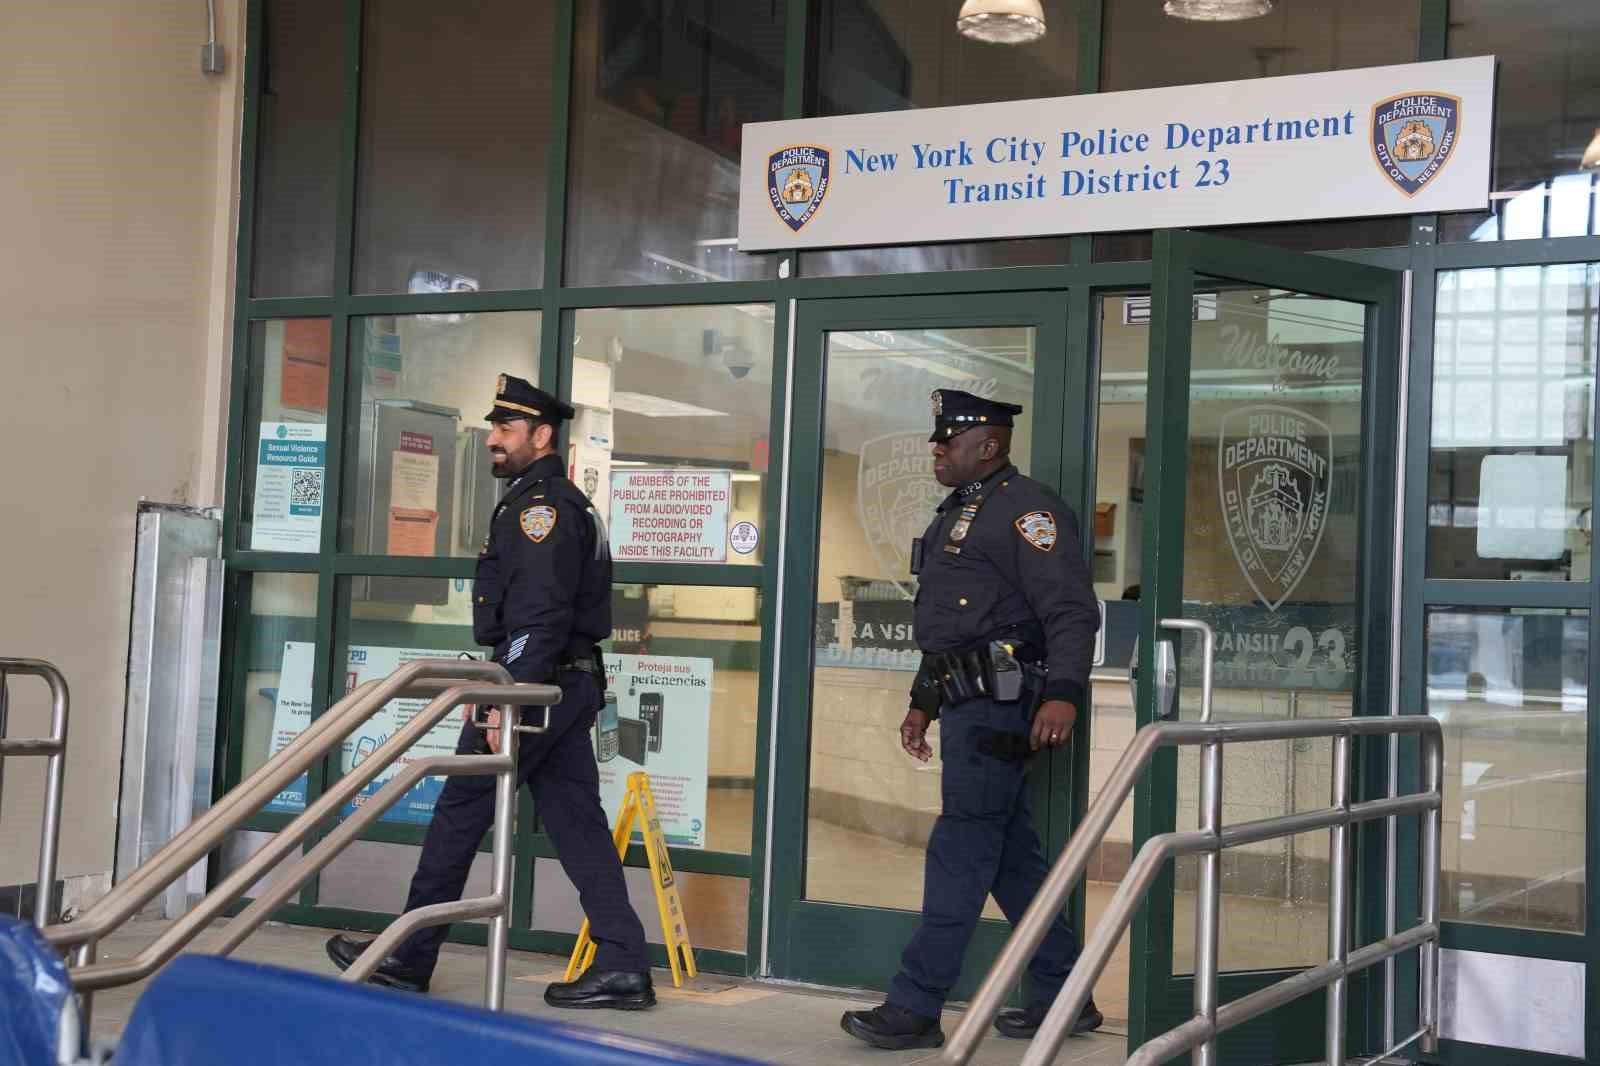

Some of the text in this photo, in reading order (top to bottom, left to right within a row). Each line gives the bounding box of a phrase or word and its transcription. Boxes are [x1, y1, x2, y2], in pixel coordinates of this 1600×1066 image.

[1394, 96, 1438, 109] POLICE
[1379, 105, 1453, 125] DEPARTMENT
[783, 147, 815, 158] POLICE
[845, 109, 1355, 175] New York City Police Department
[771, 156, 826, 172] DEPARTMENT
[1377, 143, 1405, 182] CITY OF
[1417, 129, 1454, 184] NEW YORK
[944, 158, 1231, 205] Transit District 23
[770, 187, 791, 221] CITY OF
[801, 177, 828, 223] NEW YORK
[1220, 324, 1340, 380] Welcome
[1249, 414, 1306, 442] POLICE
[268, 443, 318, 454] Sexual Violence
[1226, 437, 1327, 480] DEPARTMENT
[629, 475, 711, 487] MEMBERS OF THE
[866, 456, 931, 486] DEPART
[613, 489, 726, 501] PUBLIC ARE PROHIBITED
[624, 503, 713, 516] FROM AUDIO/VIDEO
[1226, 489, 1245, 539] CITY
[632, 518, 703, 529] RECORDING OR
[632, 531, 703, 543] PHOTOGRAPHY
[1280, 490, 1325, 589] NEW YORK
[619, 545, 715, 558] INSIDE THIS FACILITY
[638, 661, 672, 674] Proteja
[1283, 626, 1346, 688] 23
[631, 674, 706, 687] pertenencias
